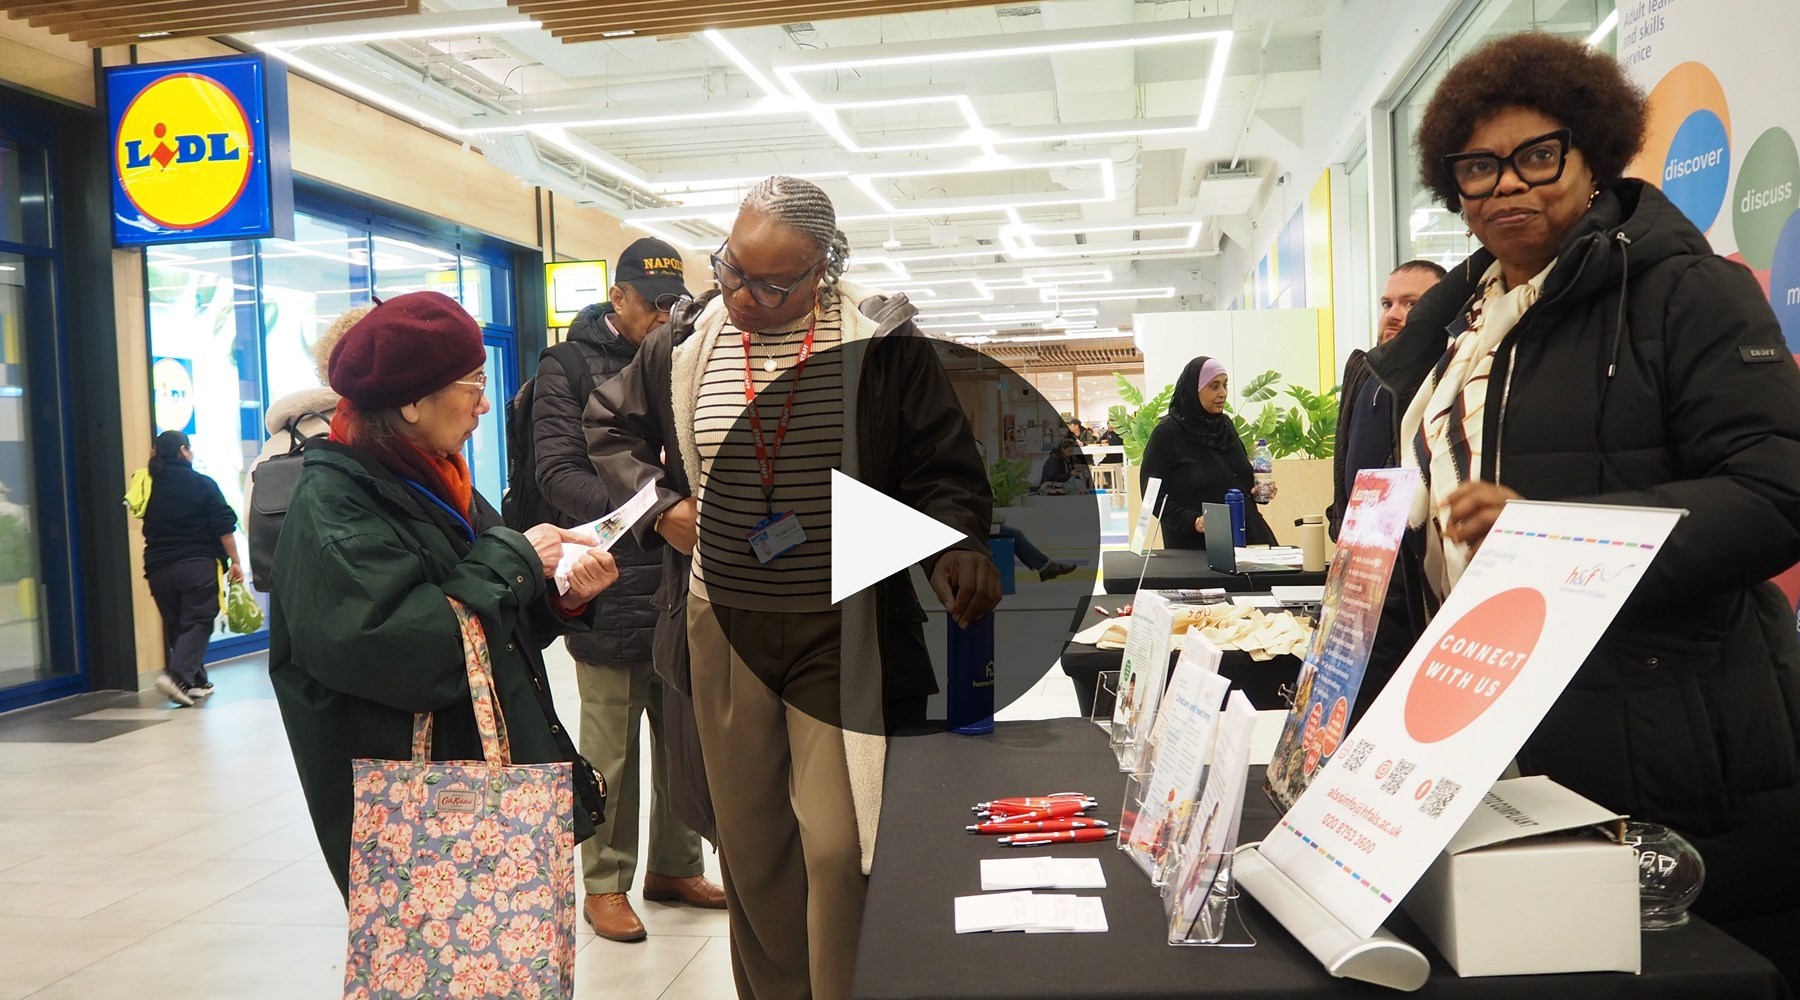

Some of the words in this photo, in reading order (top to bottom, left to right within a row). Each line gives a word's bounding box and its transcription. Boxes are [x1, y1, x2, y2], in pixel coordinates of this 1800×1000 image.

[1623, 1, 1645, 29] Adult
[1623, 26, 1636, 50] and
[1639, 14, 1665, 40] skills
[1665, 147, 1723, 181] discover
[1741, 182, 1792, 213] discuss
[752, 428, 763, 448] STAFF
[759, 459, 769, 480] STAFF
[1440, 634, 1527, 670] CONNECT
[1425, 660, 1474, 689] WITH
[1473, 676, 1501, 697] US
[1327, 787, 1403, 838] alssinfo@hfals.ac.uk
[1322, 813, 1339, 830] 020
[1335, 822, 1357, 842] 8753
[1353, 834, 1376, 855] 3600
